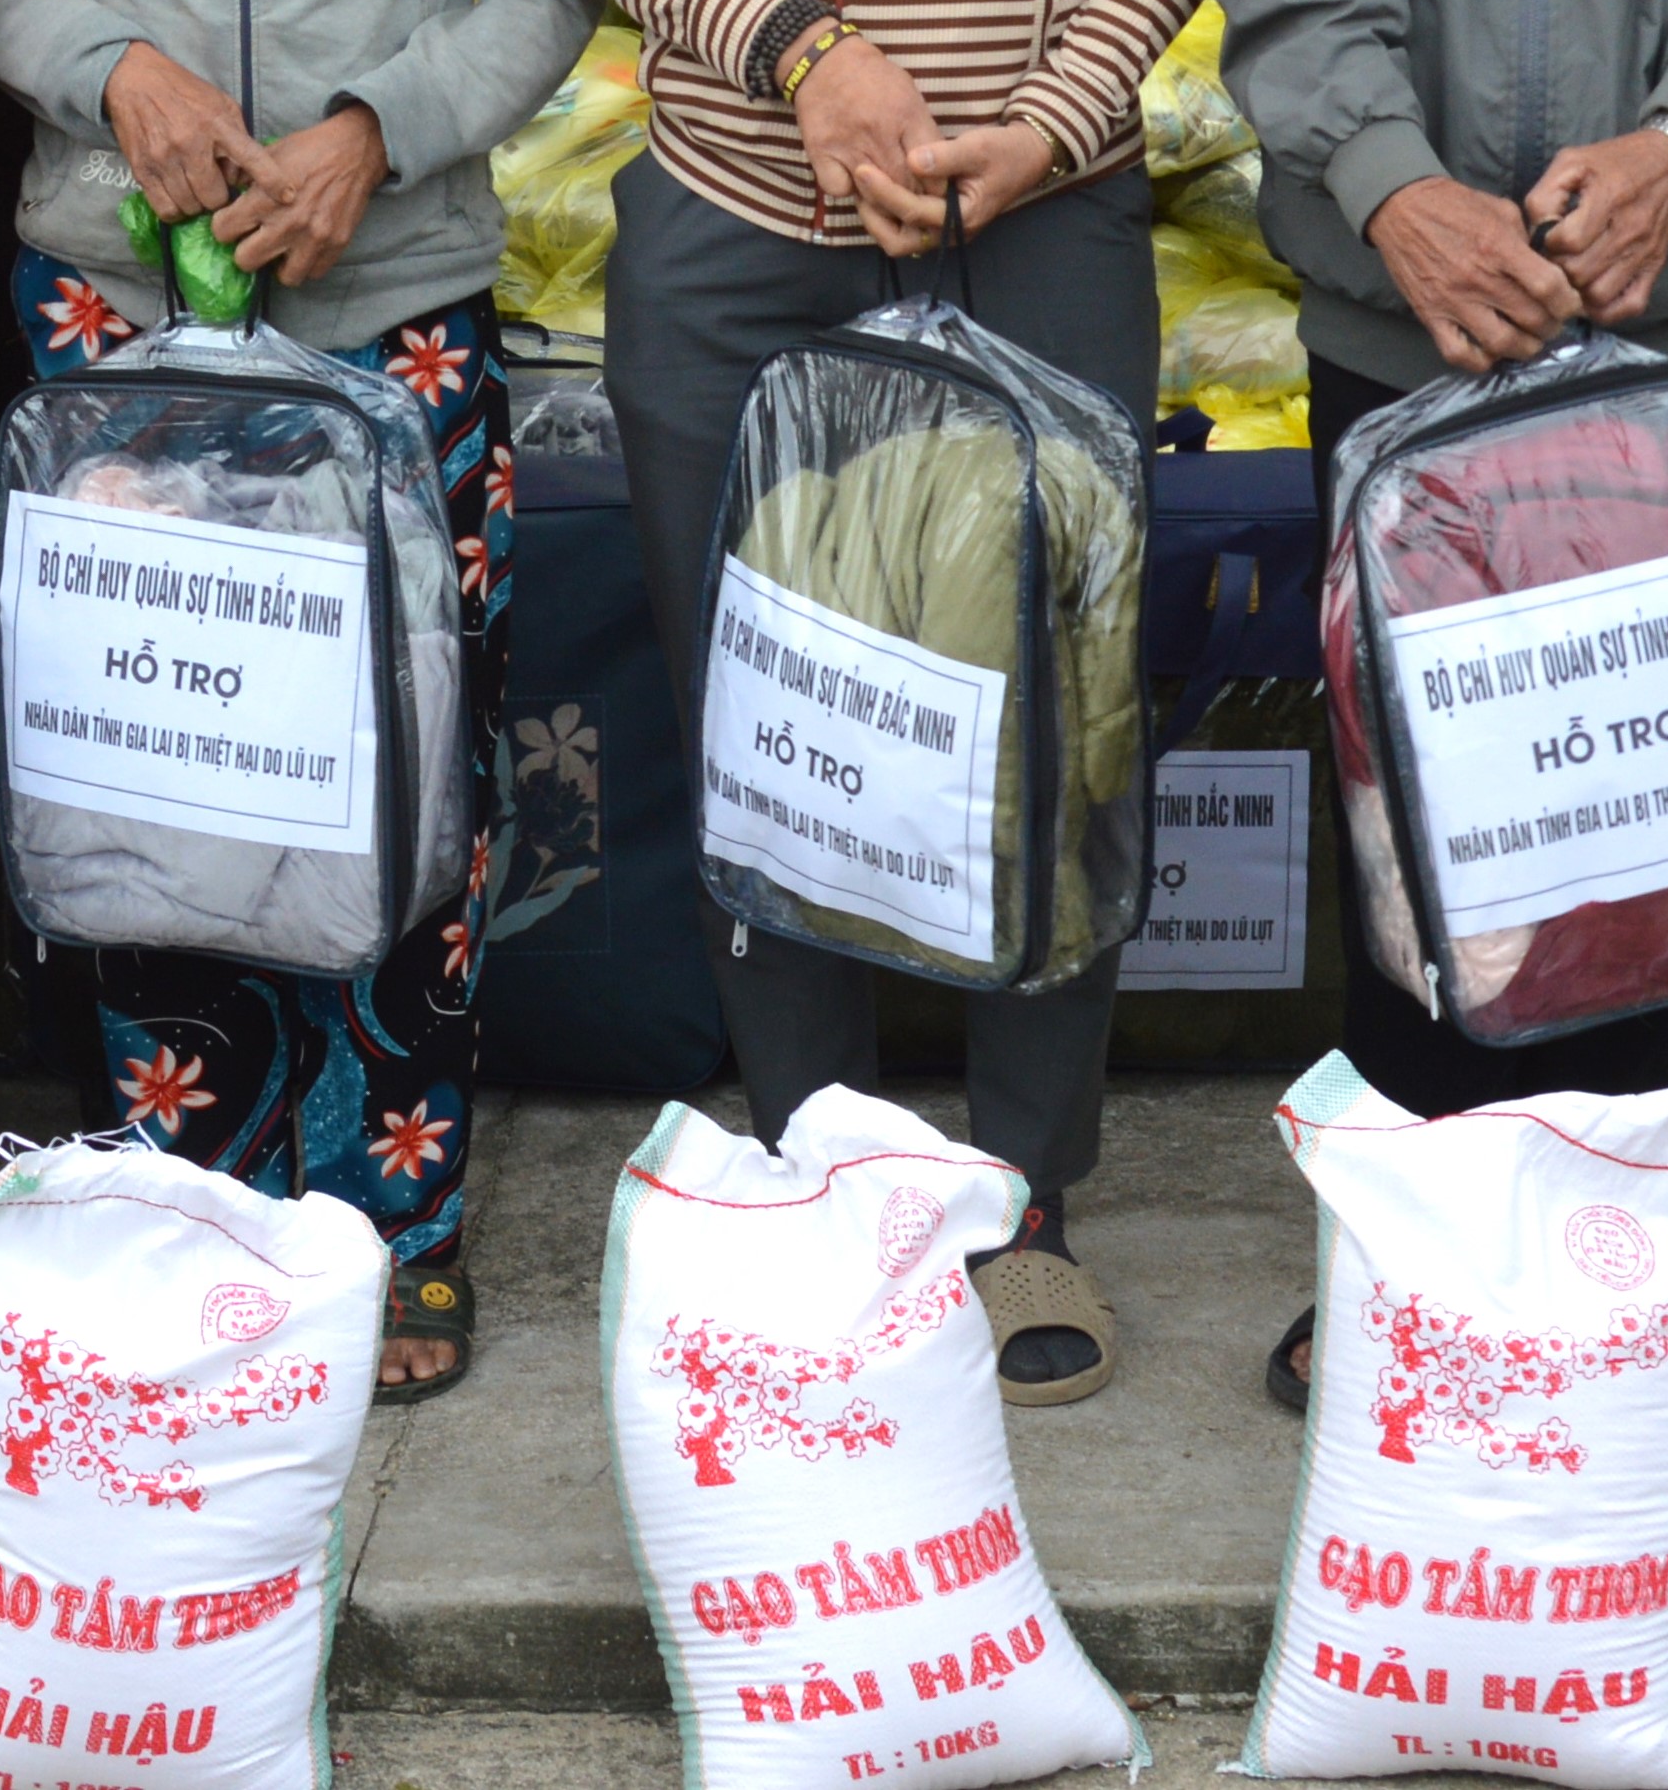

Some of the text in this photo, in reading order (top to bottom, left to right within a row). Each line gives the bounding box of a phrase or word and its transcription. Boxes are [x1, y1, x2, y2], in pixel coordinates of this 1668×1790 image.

[105, 639, 243, 708] HỖ TRỢ
[754, 719, 864, 804] HỖ TRỢ
[1532, 716, 1596, 773] HỖ
[1155, 782, 1274, 827] TỈNH BẮC NINH
[1148, 915, 1274, 945] THIỆT HẠI DO LŨ LỤT
[690, 1502, 1023, 1645] GẠO TÁM THƠM
[1318, 1534, 1411, 1612] GẠO
[1422, 1545, 1538, 1621] TÁM
[51, 1575, 165, 1653] TÁM
[172, 1566, 302, 1650] THƠM
[737, 1613, 1046, 1723] HẢI HẬU
[1313, 1640, 1649, 1723] HẢI HẬU
[84, 1702, 218, 1765] HẬU
[842, 1750, 885, 1780] TL
[914, 1720, 1000, 1763] 10KG
[1392, 1733, 1436, 1756] TL
[1470, 1739, 1558, 1768] 10KG
